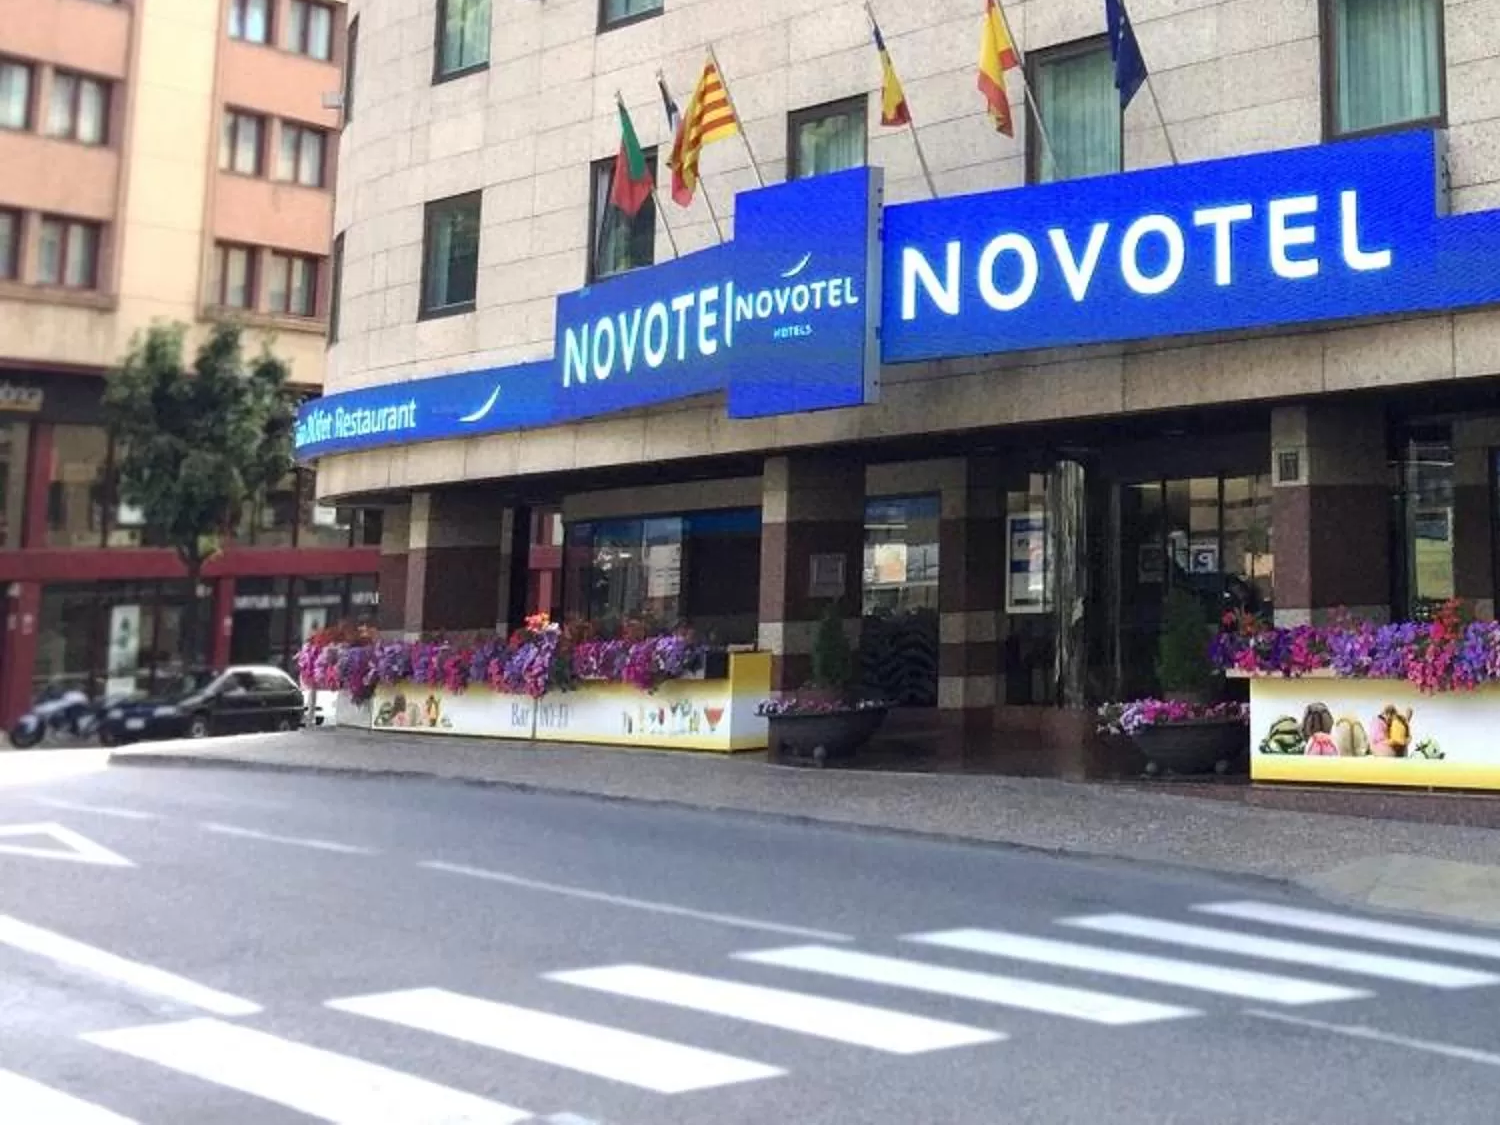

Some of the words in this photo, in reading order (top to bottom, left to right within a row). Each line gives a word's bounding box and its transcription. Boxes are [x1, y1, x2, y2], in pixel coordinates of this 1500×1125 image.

[901, 190, 1392, 321] NOVOTEL
[735, 276, 859, 322] NOVOTEL
[773, 324, 813, 339] HOTELS
[335, 398, 417, 438] Restaurant
